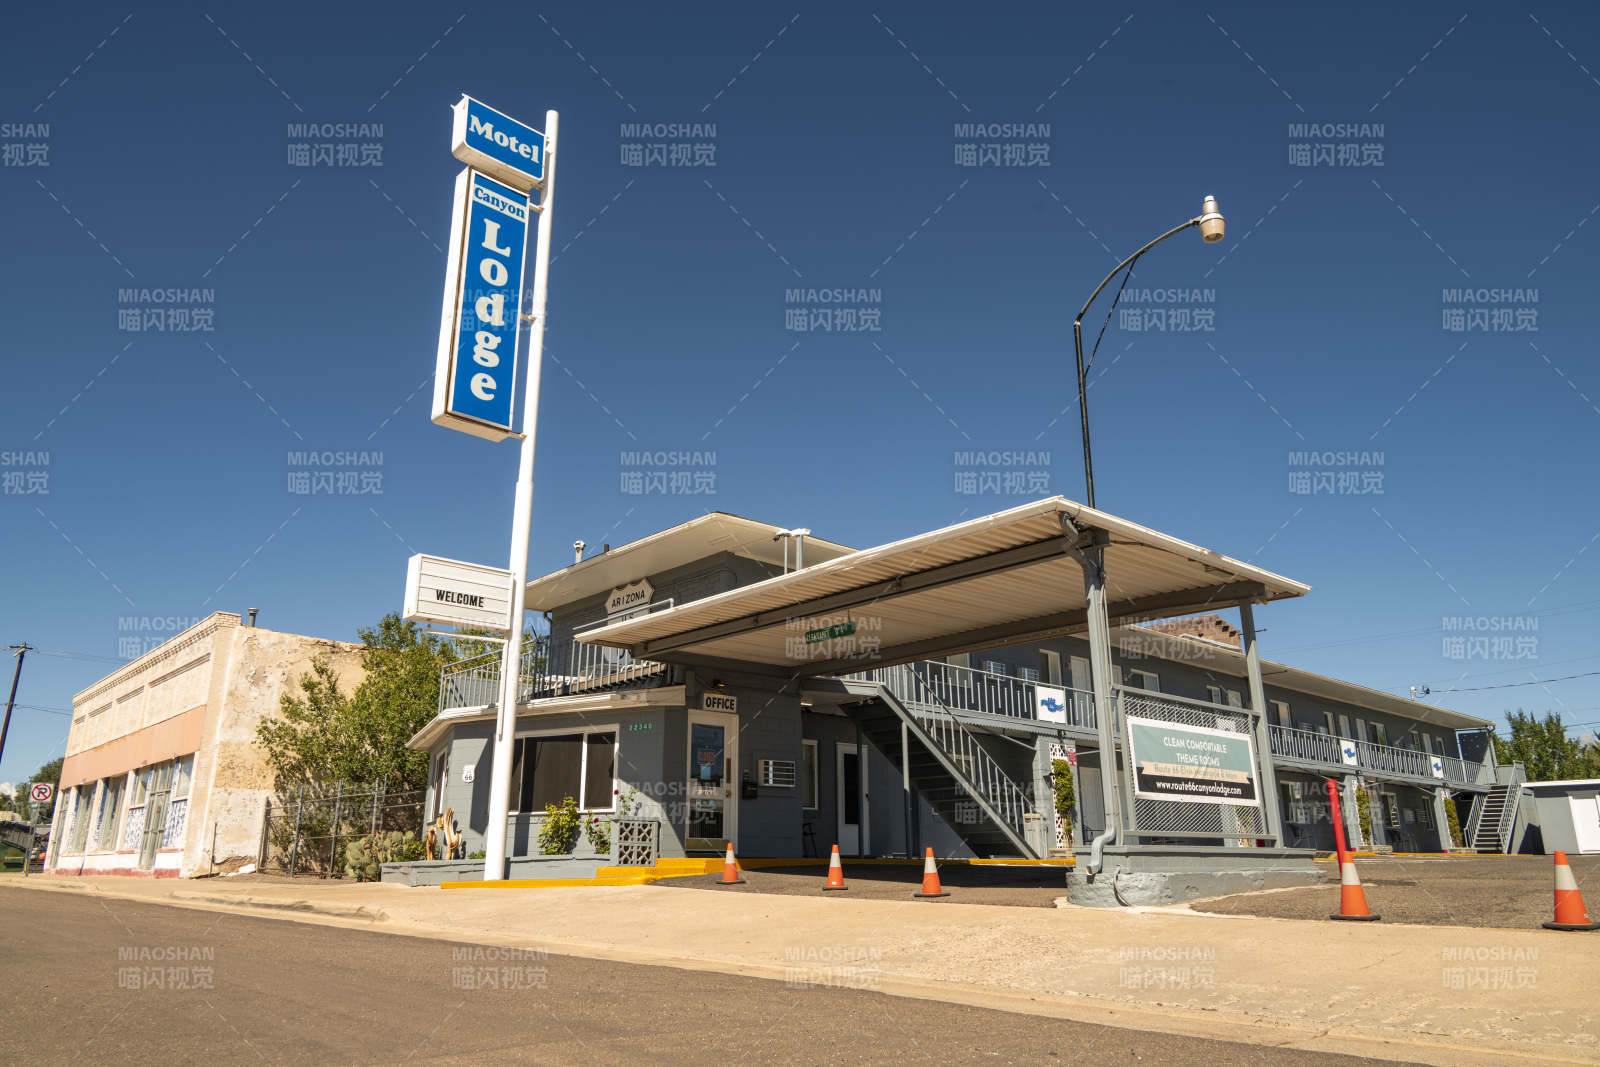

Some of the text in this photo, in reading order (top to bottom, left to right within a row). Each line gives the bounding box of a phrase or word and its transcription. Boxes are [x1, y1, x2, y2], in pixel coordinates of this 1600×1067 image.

[469, 114, 539, 164] Motel
[474, 187, 525, 219] Canyon
[470, 218, 511, 401] Lodge
[435, 589, 485, 608] WELCOME
[611, 589, 645, 608] ARIZONA
[705, 696, 735, 711] OFFICE
[1163, 737, 1228, 754] CLEAN COMFORTABLE
[1176, 753, 1220, 767] THEME ROOMS
[1156, 781, 1242, 796] www.route66canyonlodge.com
